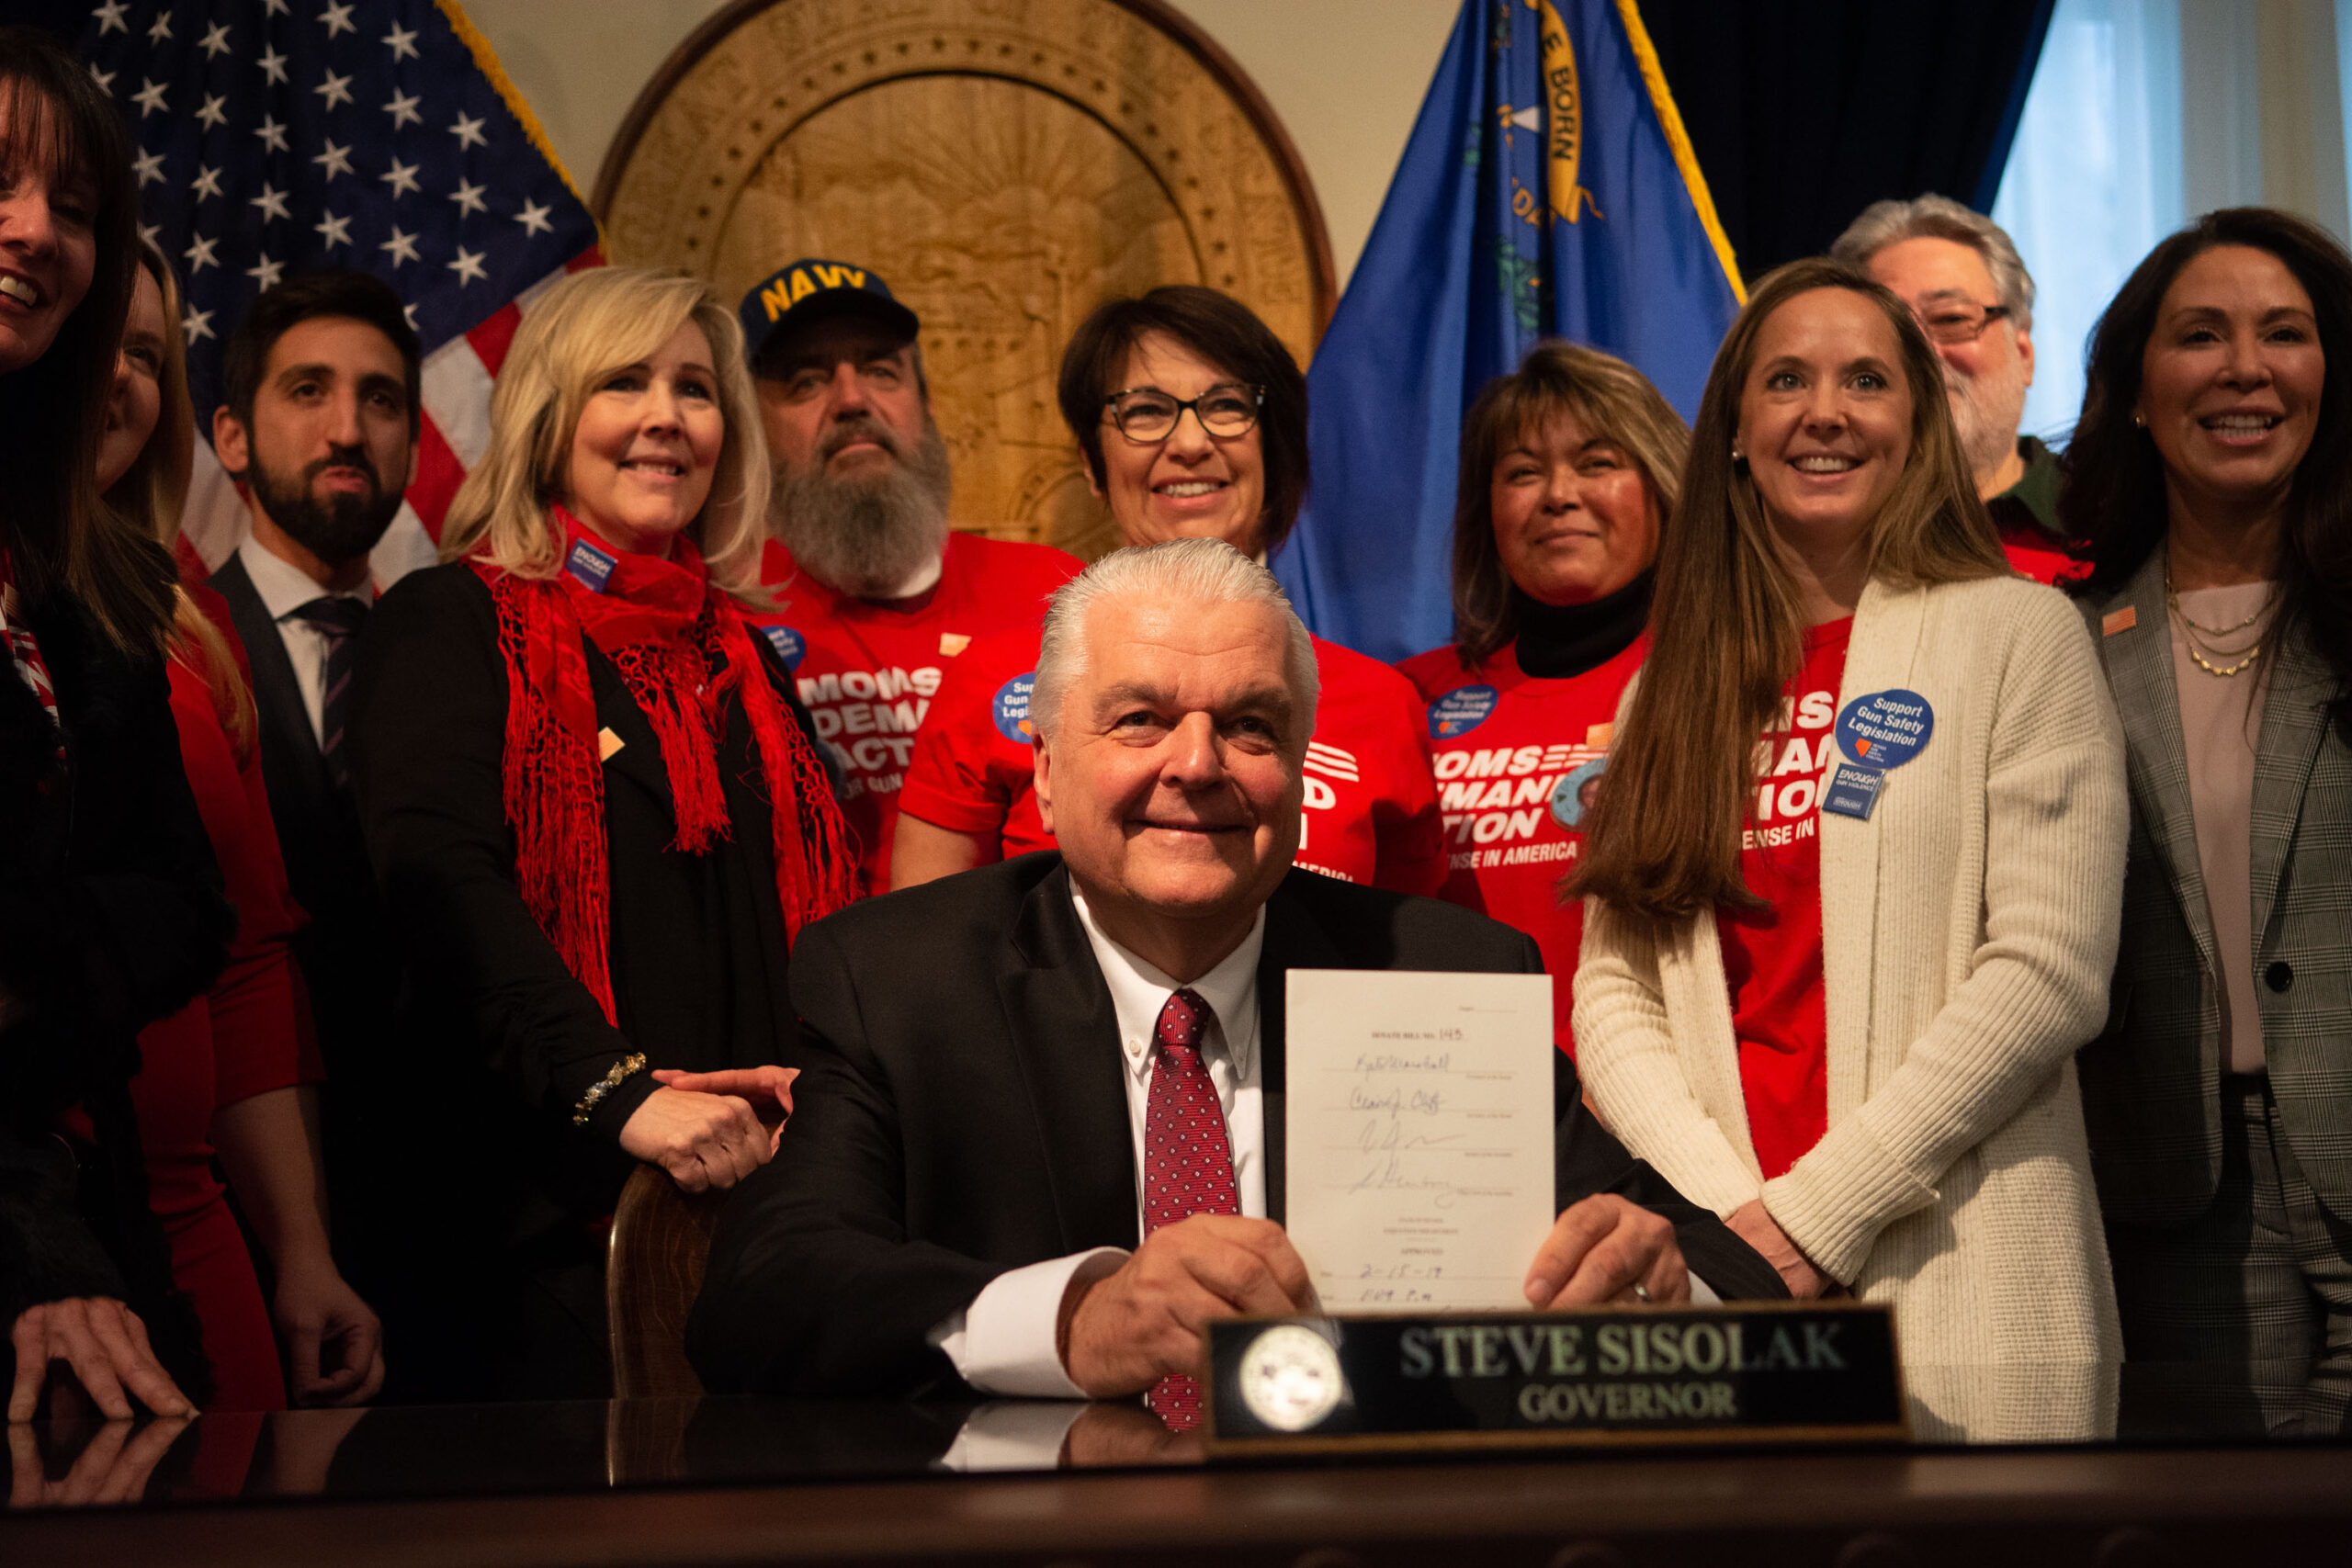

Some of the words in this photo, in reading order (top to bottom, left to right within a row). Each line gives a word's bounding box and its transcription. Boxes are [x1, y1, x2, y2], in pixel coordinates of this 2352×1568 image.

[1550, 66, 1577, 162] BORN
[760, 264, 865, 323] NAVY
[796, 666, 943, 706] MOMS
[1003, 694, 1030, 705] Gun
[1857, 705, 1883, 724] Gun
[1883, 714, 1925, 736] Safety
[1873, 696, 1923, 717] Support
[1848, 716, 1917, 747] Legislation
[1432, 745, 1543, 780] OMS
[1838, 769, 1879, 785] ENOUGH
[1795, 817, 1815, 840] IN
[1482, 849, 1502, 867] IN
[1503, 841, 1577, 865] AMERICA
[1399, 1324, 1588, 1378] STEVE
[1595, 1321, 1849, 1375] SISOLAK
[1517, 1381, 1739, 1423] GOVERNOR
